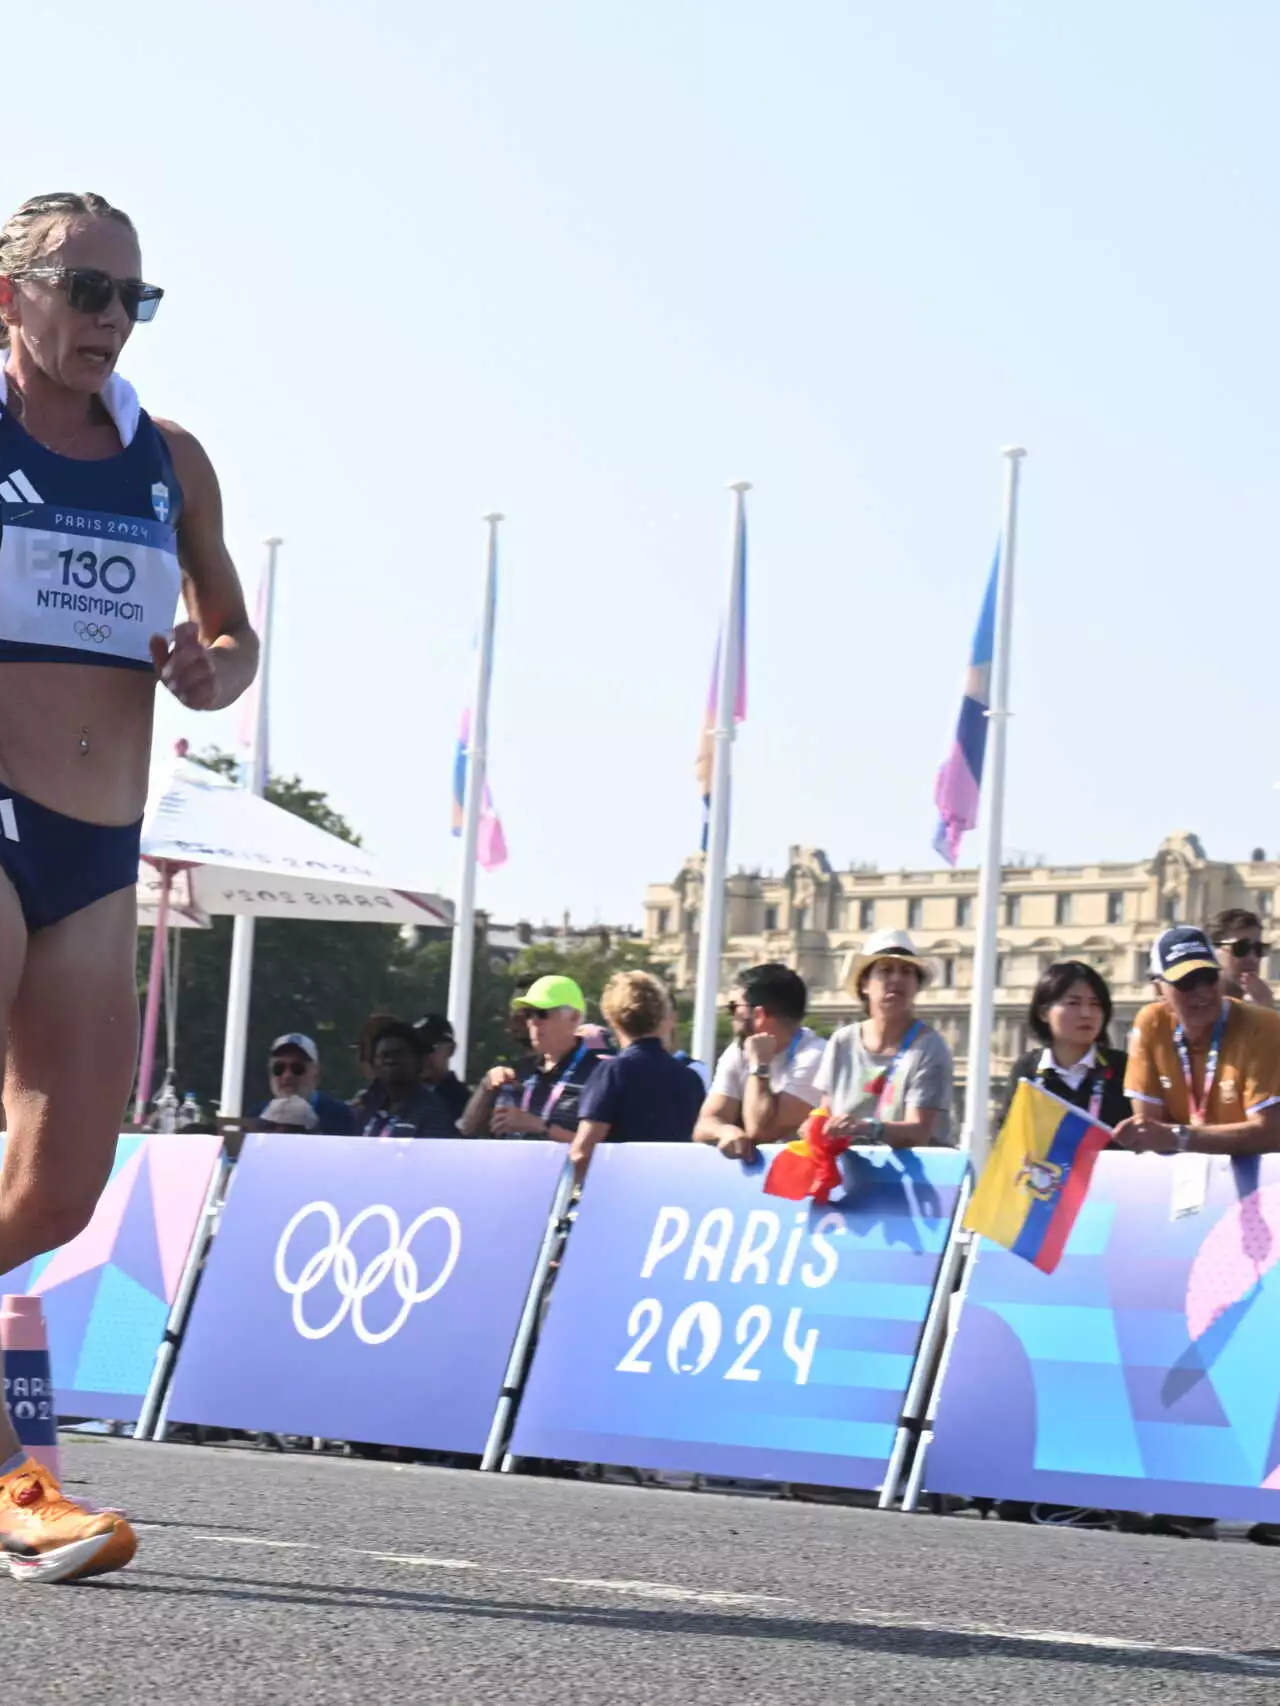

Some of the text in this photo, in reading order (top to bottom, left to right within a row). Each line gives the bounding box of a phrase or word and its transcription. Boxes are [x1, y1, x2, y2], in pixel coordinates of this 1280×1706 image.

[55, 513, 150, 538] PARIS 2024
[58, 547, 136, 594] 130
[36, 589, 144, 623] NTRISMPIOTI
[615, 1298, 820, 1385] 2024
